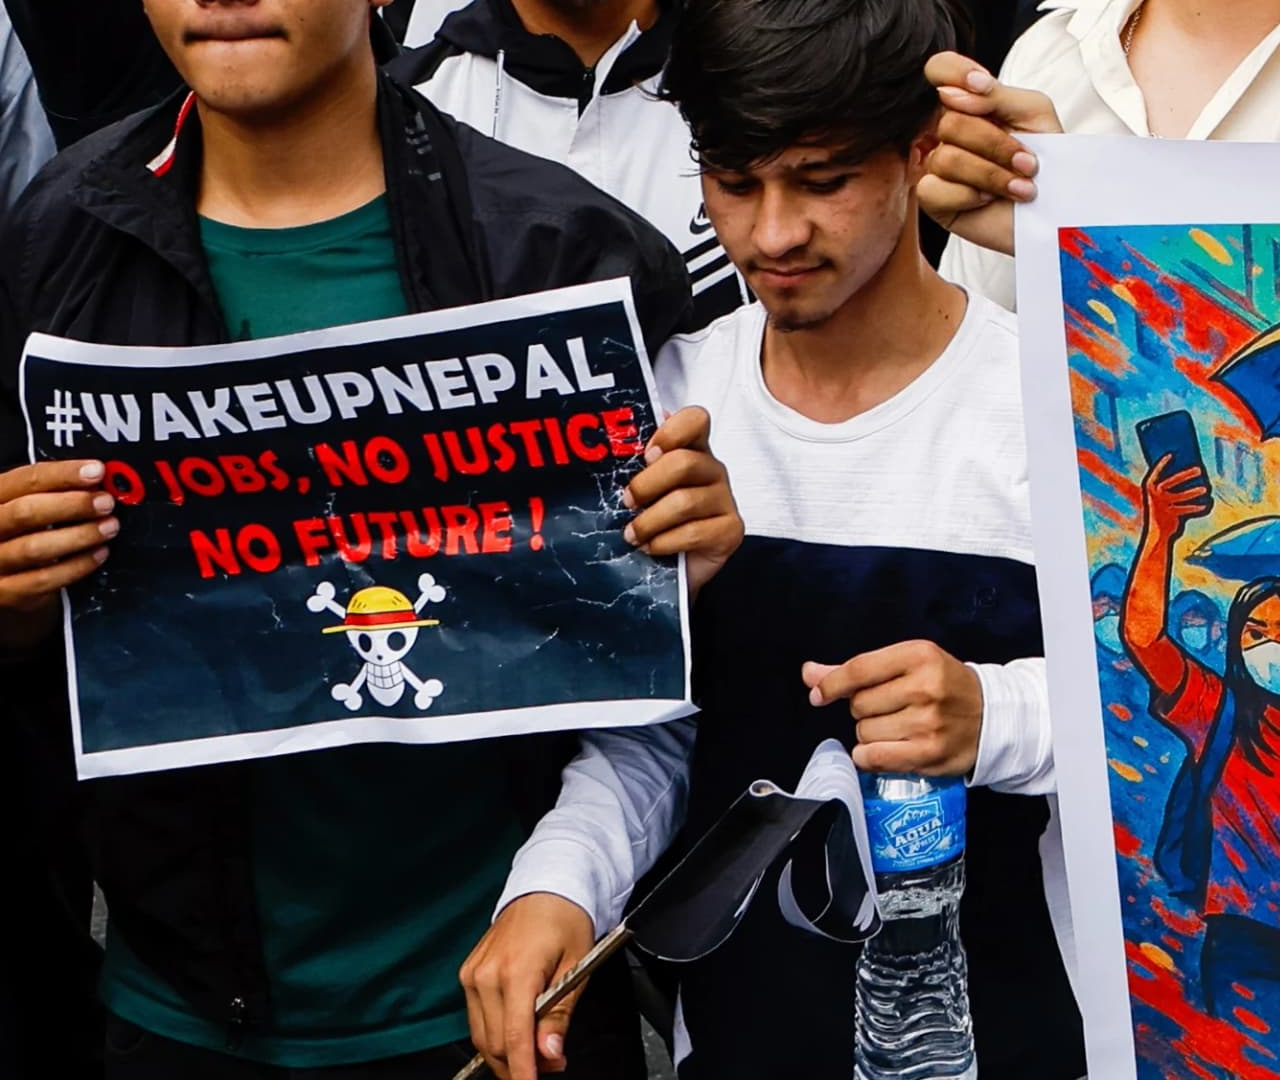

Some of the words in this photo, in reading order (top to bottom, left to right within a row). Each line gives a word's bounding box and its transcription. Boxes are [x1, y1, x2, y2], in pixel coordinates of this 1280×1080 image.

[45, 336, 614, 447] #WAKEUPNEPAL
[103, 460, 145, 506] O
[157, 449, 310, 506] JOBS,
[315, 436, 409, 487] NO
[423, 407, 643, 483] JUSTICE
[190, 522, 282, 580] NO
[293, 501, 513, 567] FUTURE
[895, 817, 942, 848] AQUA
